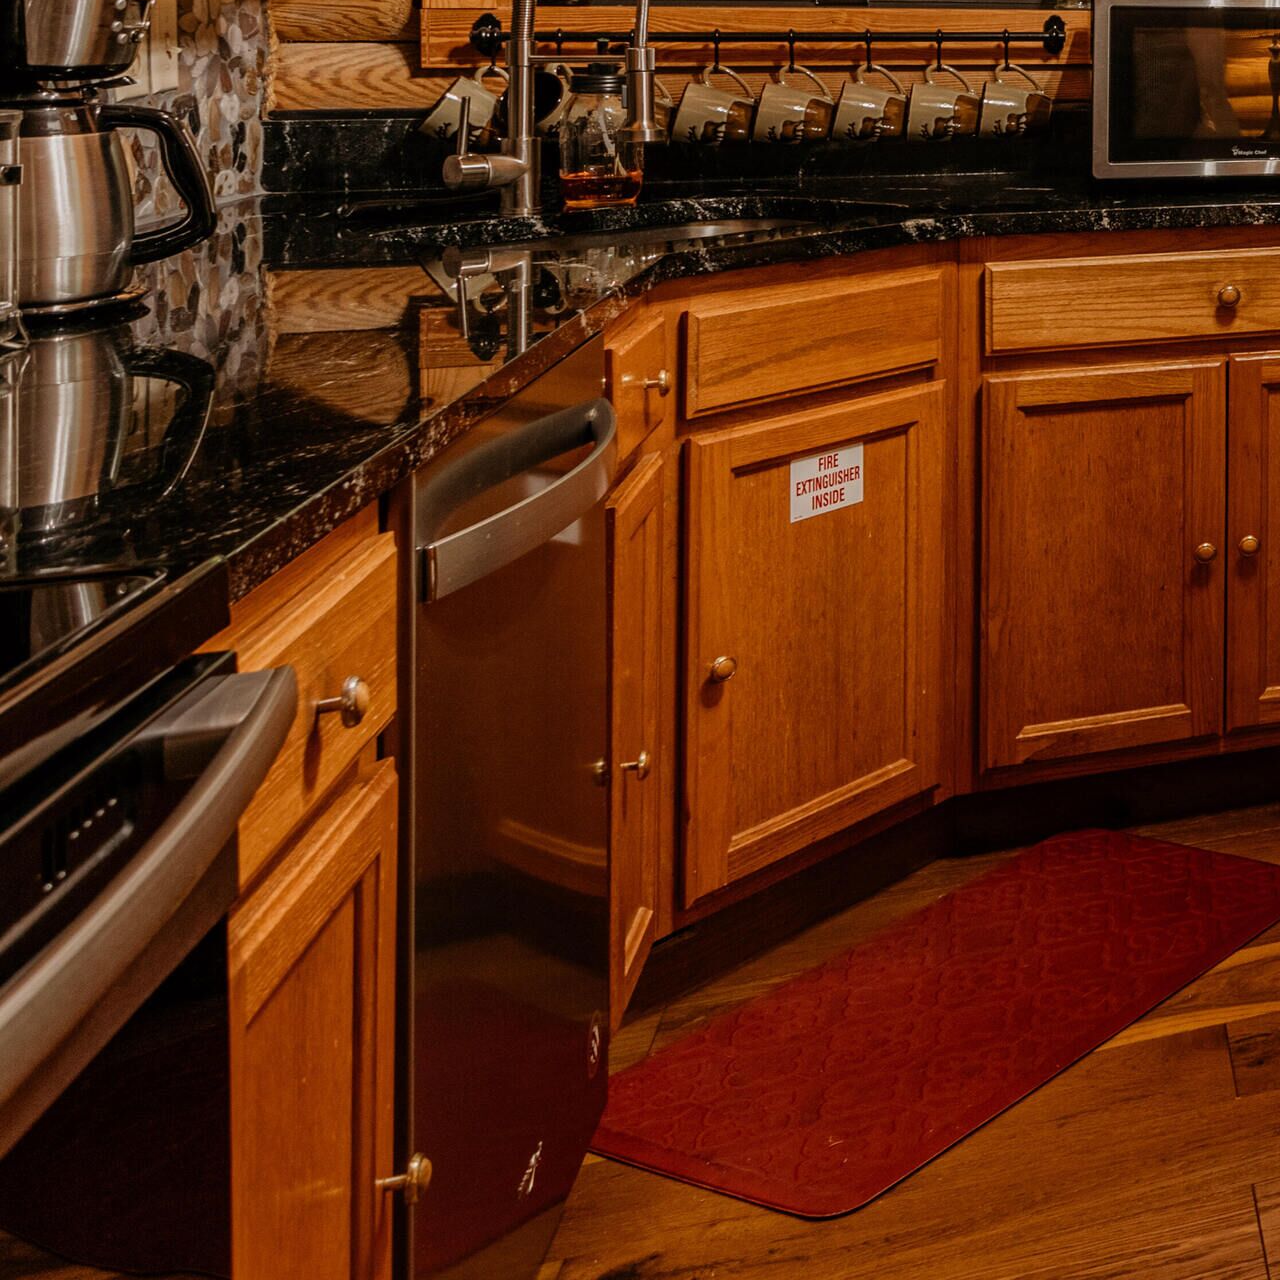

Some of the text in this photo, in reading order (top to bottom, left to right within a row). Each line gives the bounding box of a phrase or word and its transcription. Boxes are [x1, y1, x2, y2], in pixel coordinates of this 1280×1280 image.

[818, 453, 839, 472] FIRE
[796, 466, 860, 496] EXTINGUISHER
[812, 488, 845, 510] INSIDE
